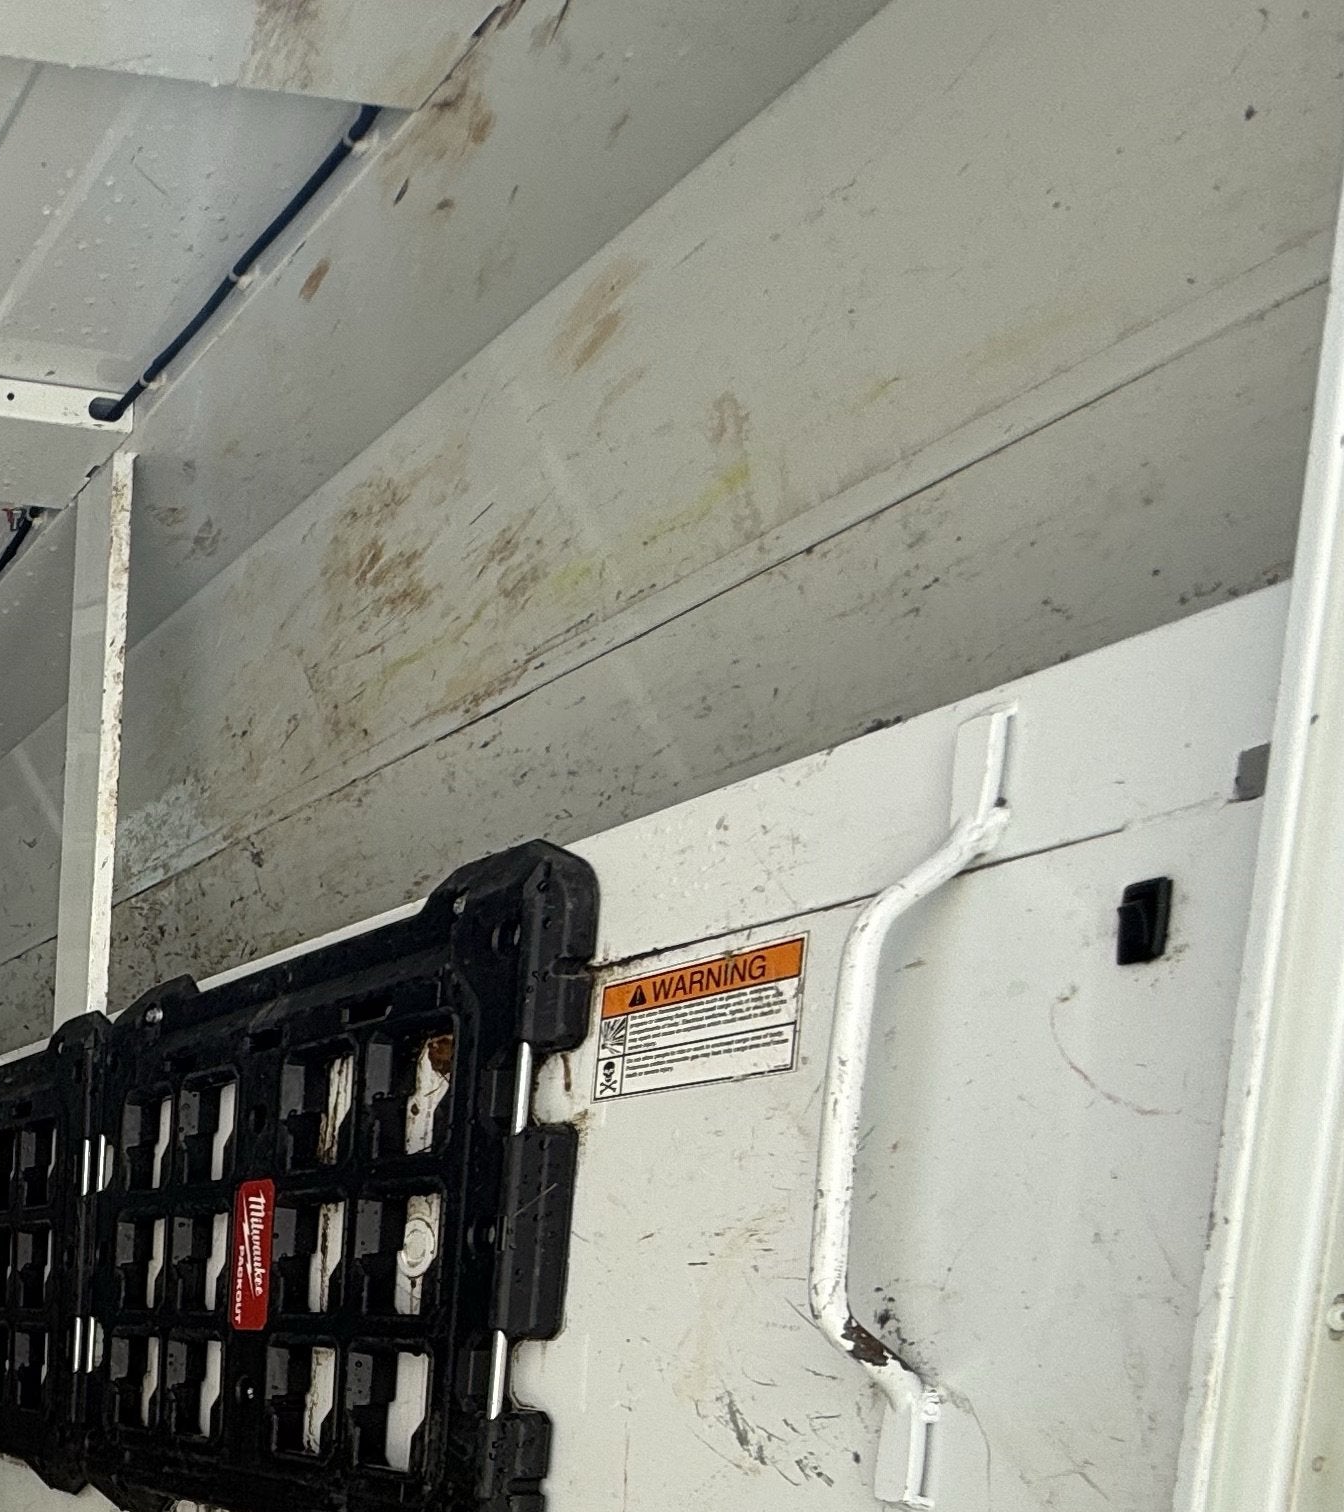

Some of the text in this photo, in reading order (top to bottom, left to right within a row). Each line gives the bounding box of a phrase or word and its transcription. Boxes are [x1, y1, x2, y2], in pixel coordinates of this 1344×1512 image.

[652, 955, 767, 1003] WARNING
[248, 1189, 266, 1297] Milwaukee
[234, 1245, 245, 1325] PACKOUT
